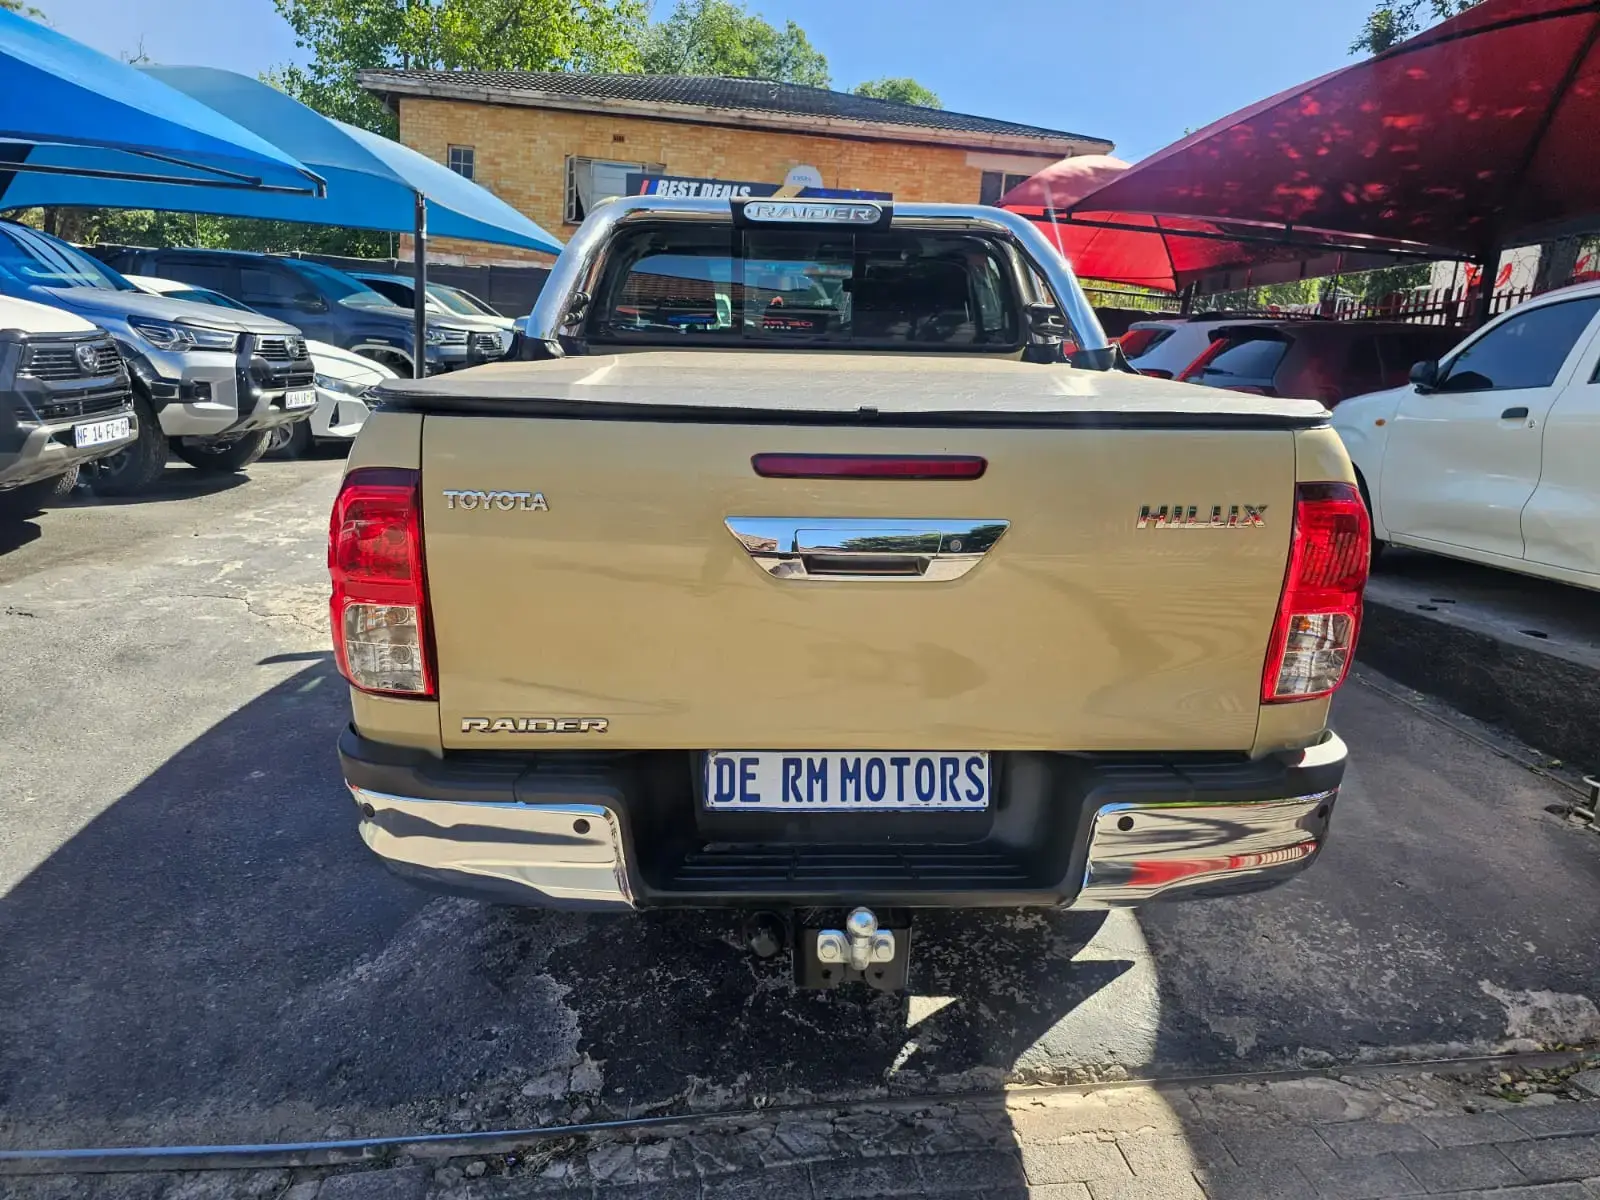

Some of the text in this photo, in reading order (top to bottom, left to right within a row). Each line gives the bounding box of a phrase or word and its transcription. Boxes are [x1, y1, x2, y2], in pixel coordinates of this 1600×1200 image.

[656, 179, 751, 199] BEST DEALS
[755, 205, 872, 221] RAIDER
[77, 427, 88, 445] NF
[93, 424, 103, 441] 14
[443, 490, 549, 511] TOYOTA
[1137, 505, 1268, 529] HILUX
[461, 717, 609, 733] RAIDER
[714, 756, 985, 802] DE RM MOTORS
